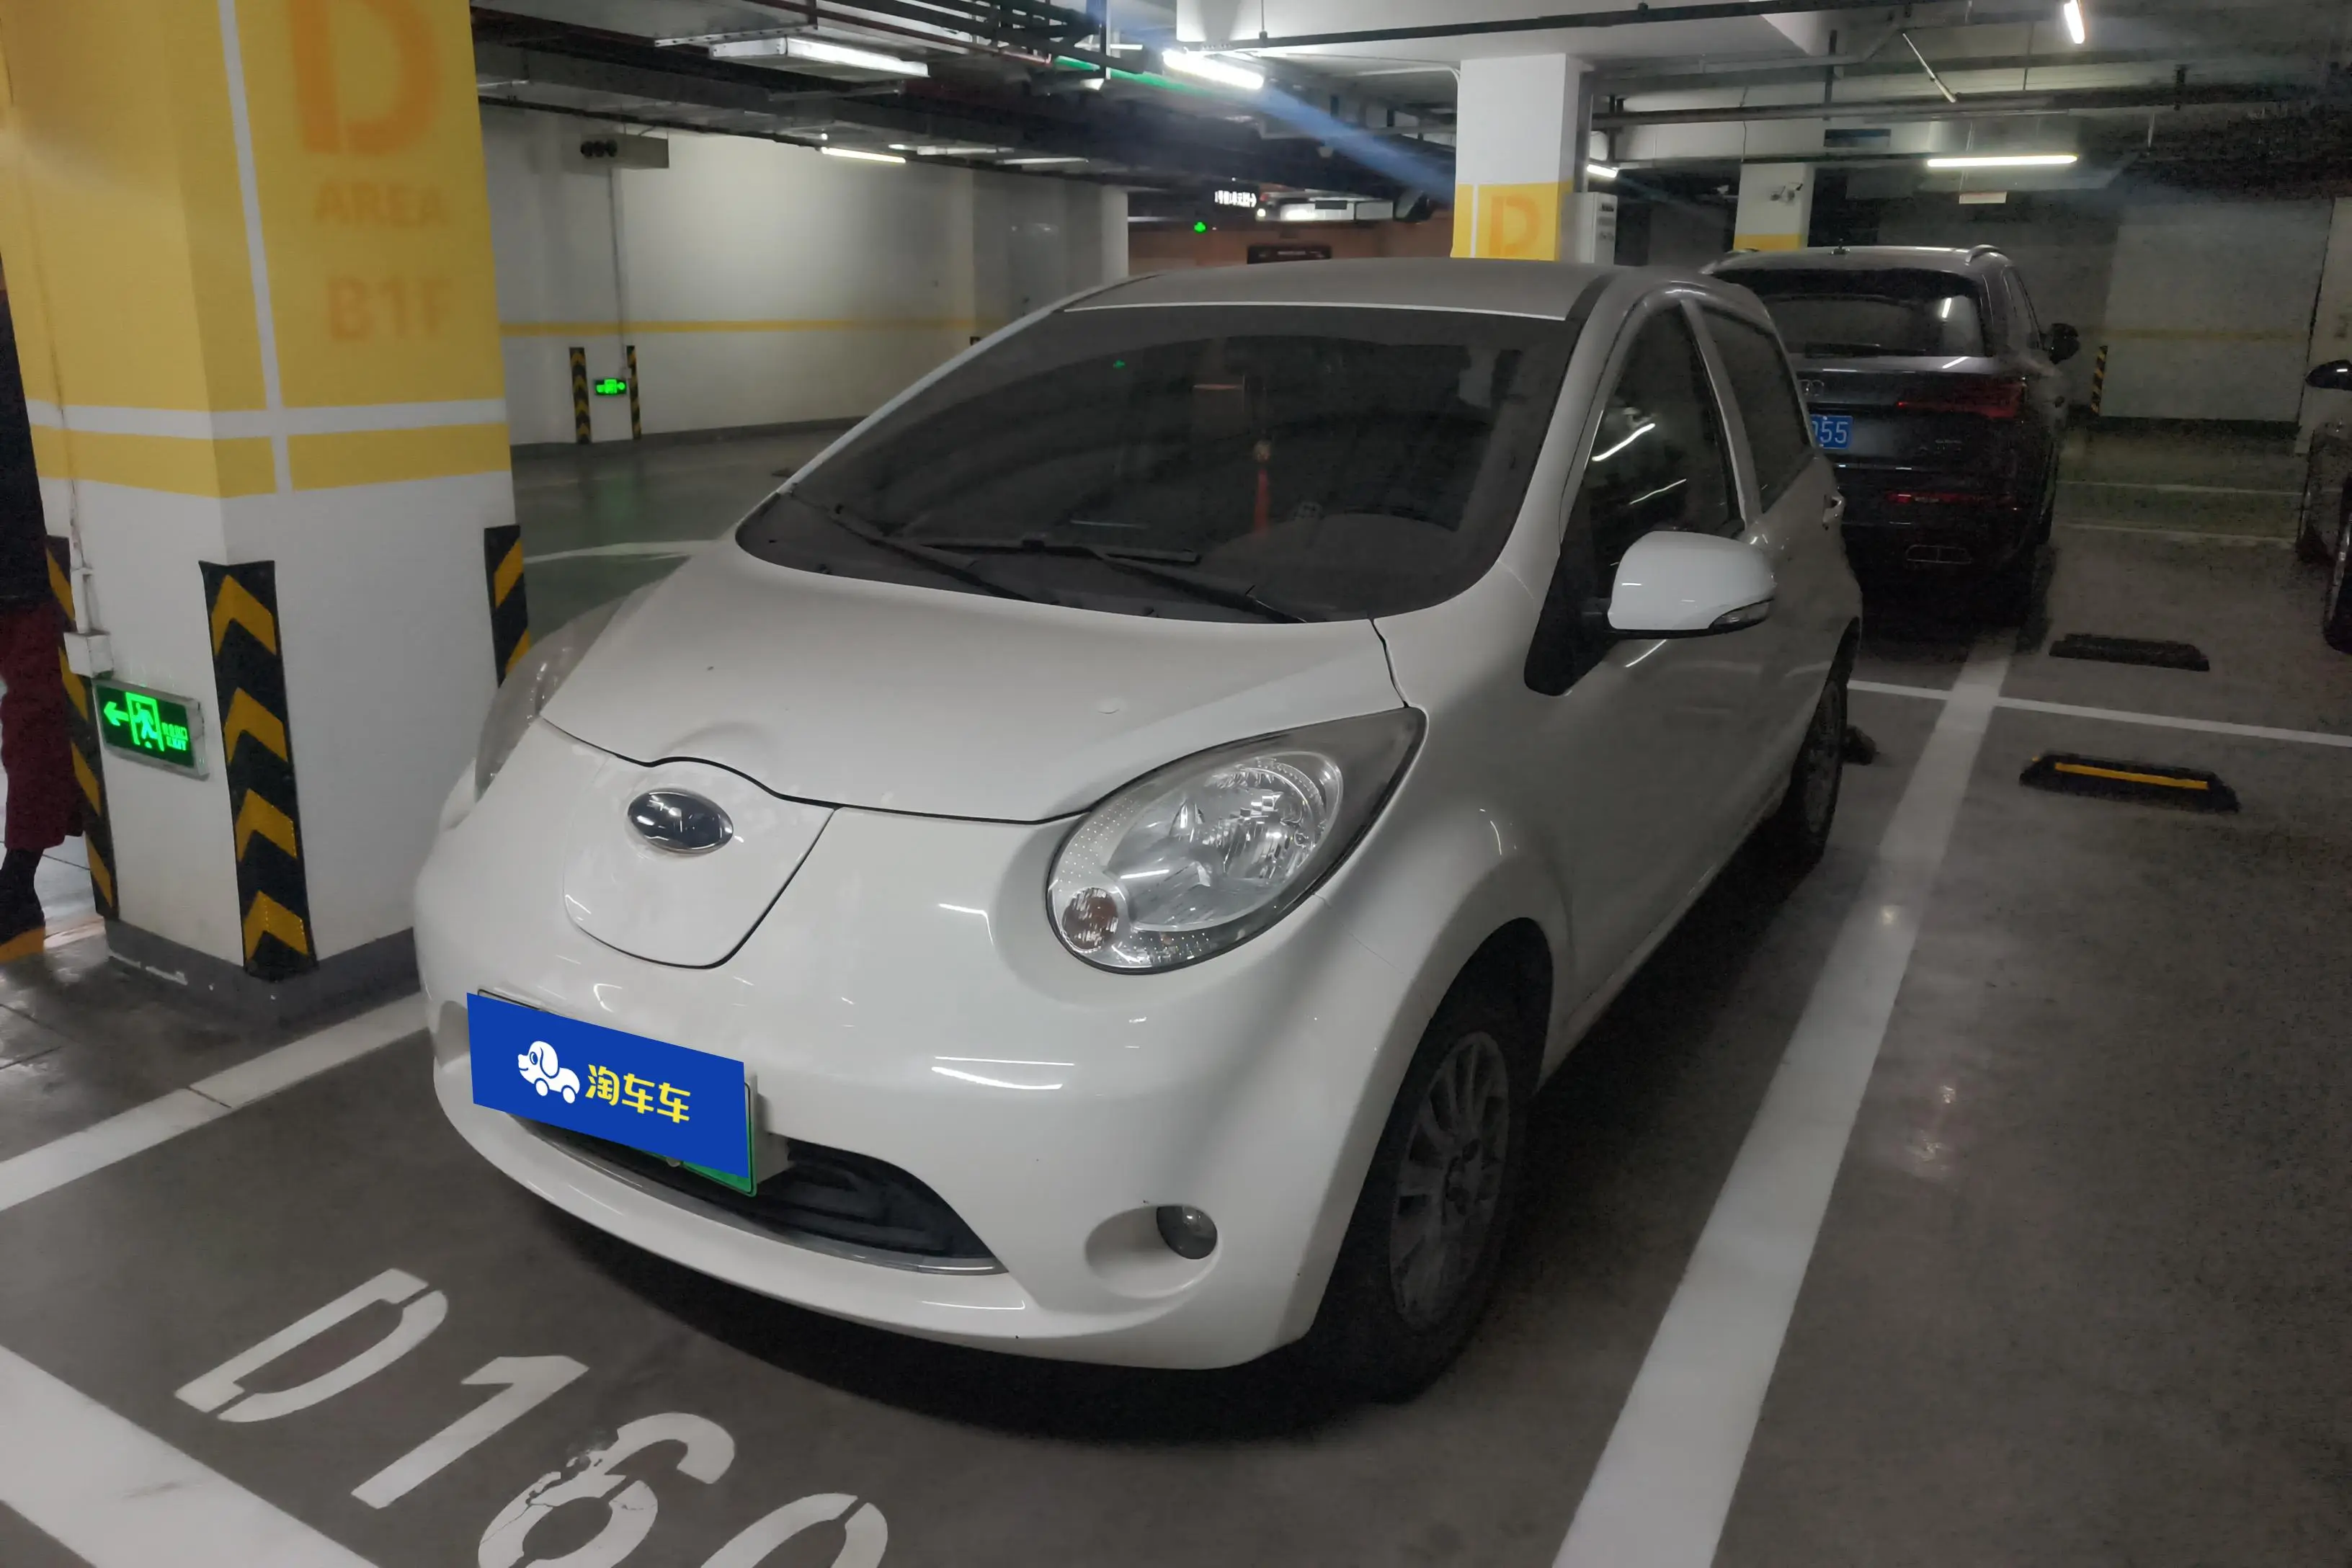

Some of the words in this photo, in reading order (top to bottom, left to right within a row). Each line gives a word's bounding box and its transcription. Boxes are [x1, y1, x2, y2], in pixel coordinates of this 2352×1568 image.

[288, 0, 438, 154] D
[316, 182, 447, 226] AREA
[1489, 195, 1540, 257] D
[328, 277, 448, 342] B1F
